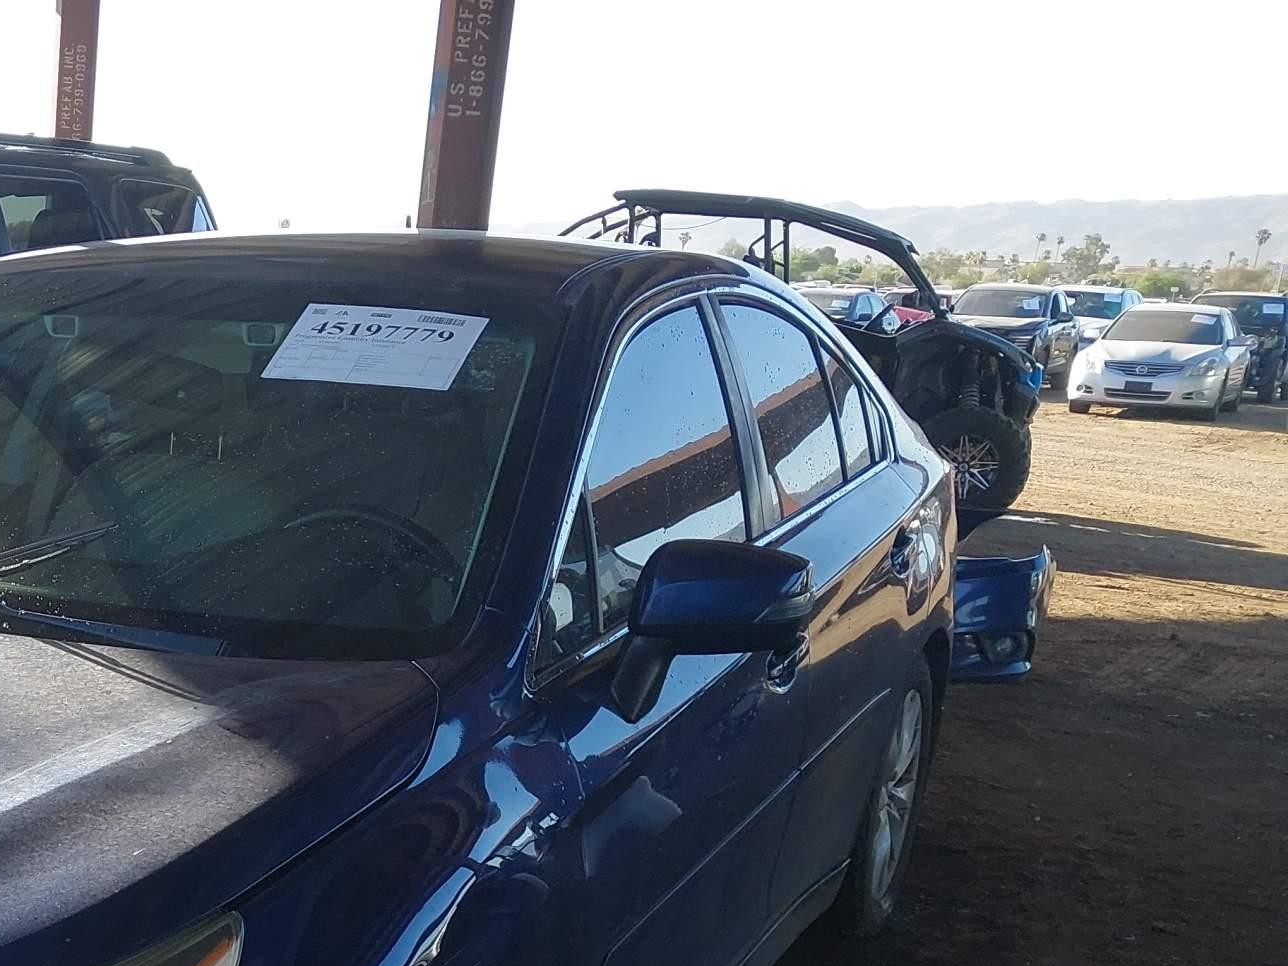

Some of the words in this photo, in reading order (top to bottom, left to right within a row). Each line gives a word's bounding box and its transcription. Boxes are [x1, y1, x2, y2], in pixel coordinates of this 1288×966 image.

[454, 0, 475, 63] PREF
[63, 43, 75, 69] INC.
[59, 75, 73, 129] PREFAB
[310, 321, 455, 343] 45197779
